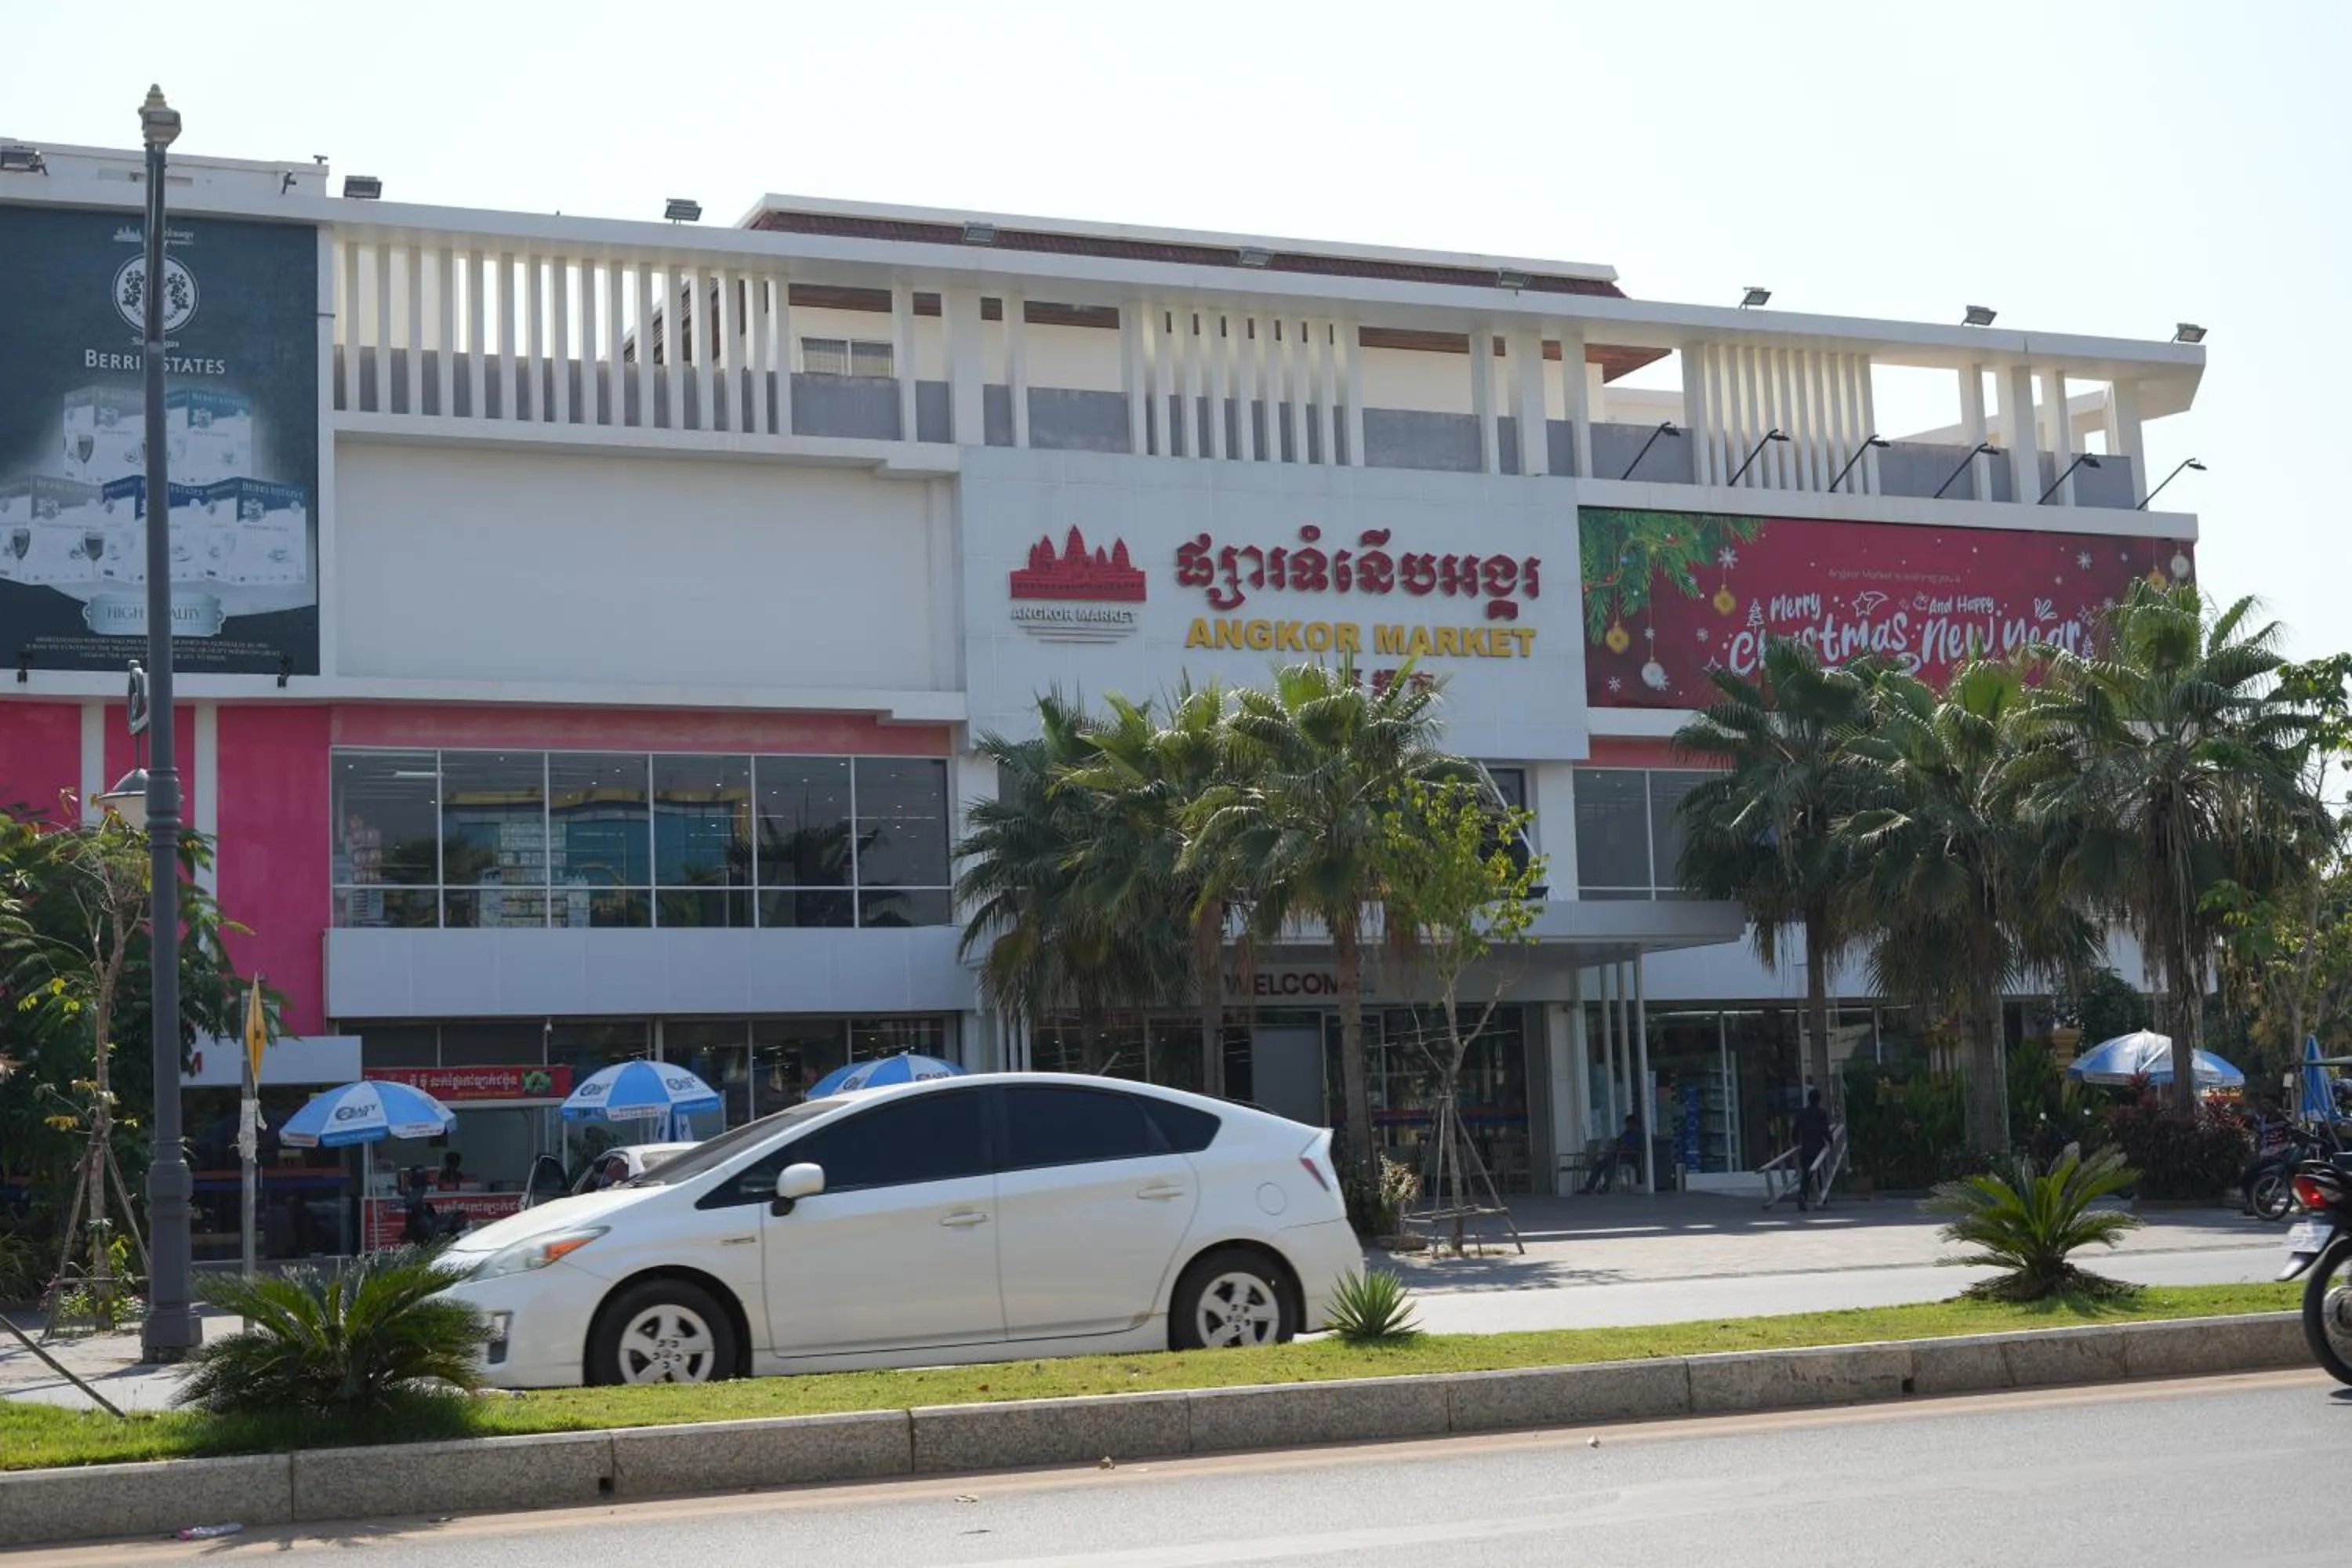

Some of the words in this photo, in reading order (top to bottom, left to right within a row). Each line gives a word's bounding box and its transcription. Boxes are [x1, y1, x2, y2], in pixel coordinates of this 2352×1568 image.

[85, 349, 140, 371] BERRI
[163, 355, 226, 375] STATES
[170, 608, 200, 621] ALITY
[1011, 606, 1074, 622] ANGKOR
[1076, 608, 1138, 625] MARKET
[1769, 592, 1821, 622] Merry
[1928, 595, 1953, 615] And
[1957, 594, 1994, 615] Happy
[1185, 617, 1361, 655] ANGKOR
[1374, 623, 1537, 659] MARKET
